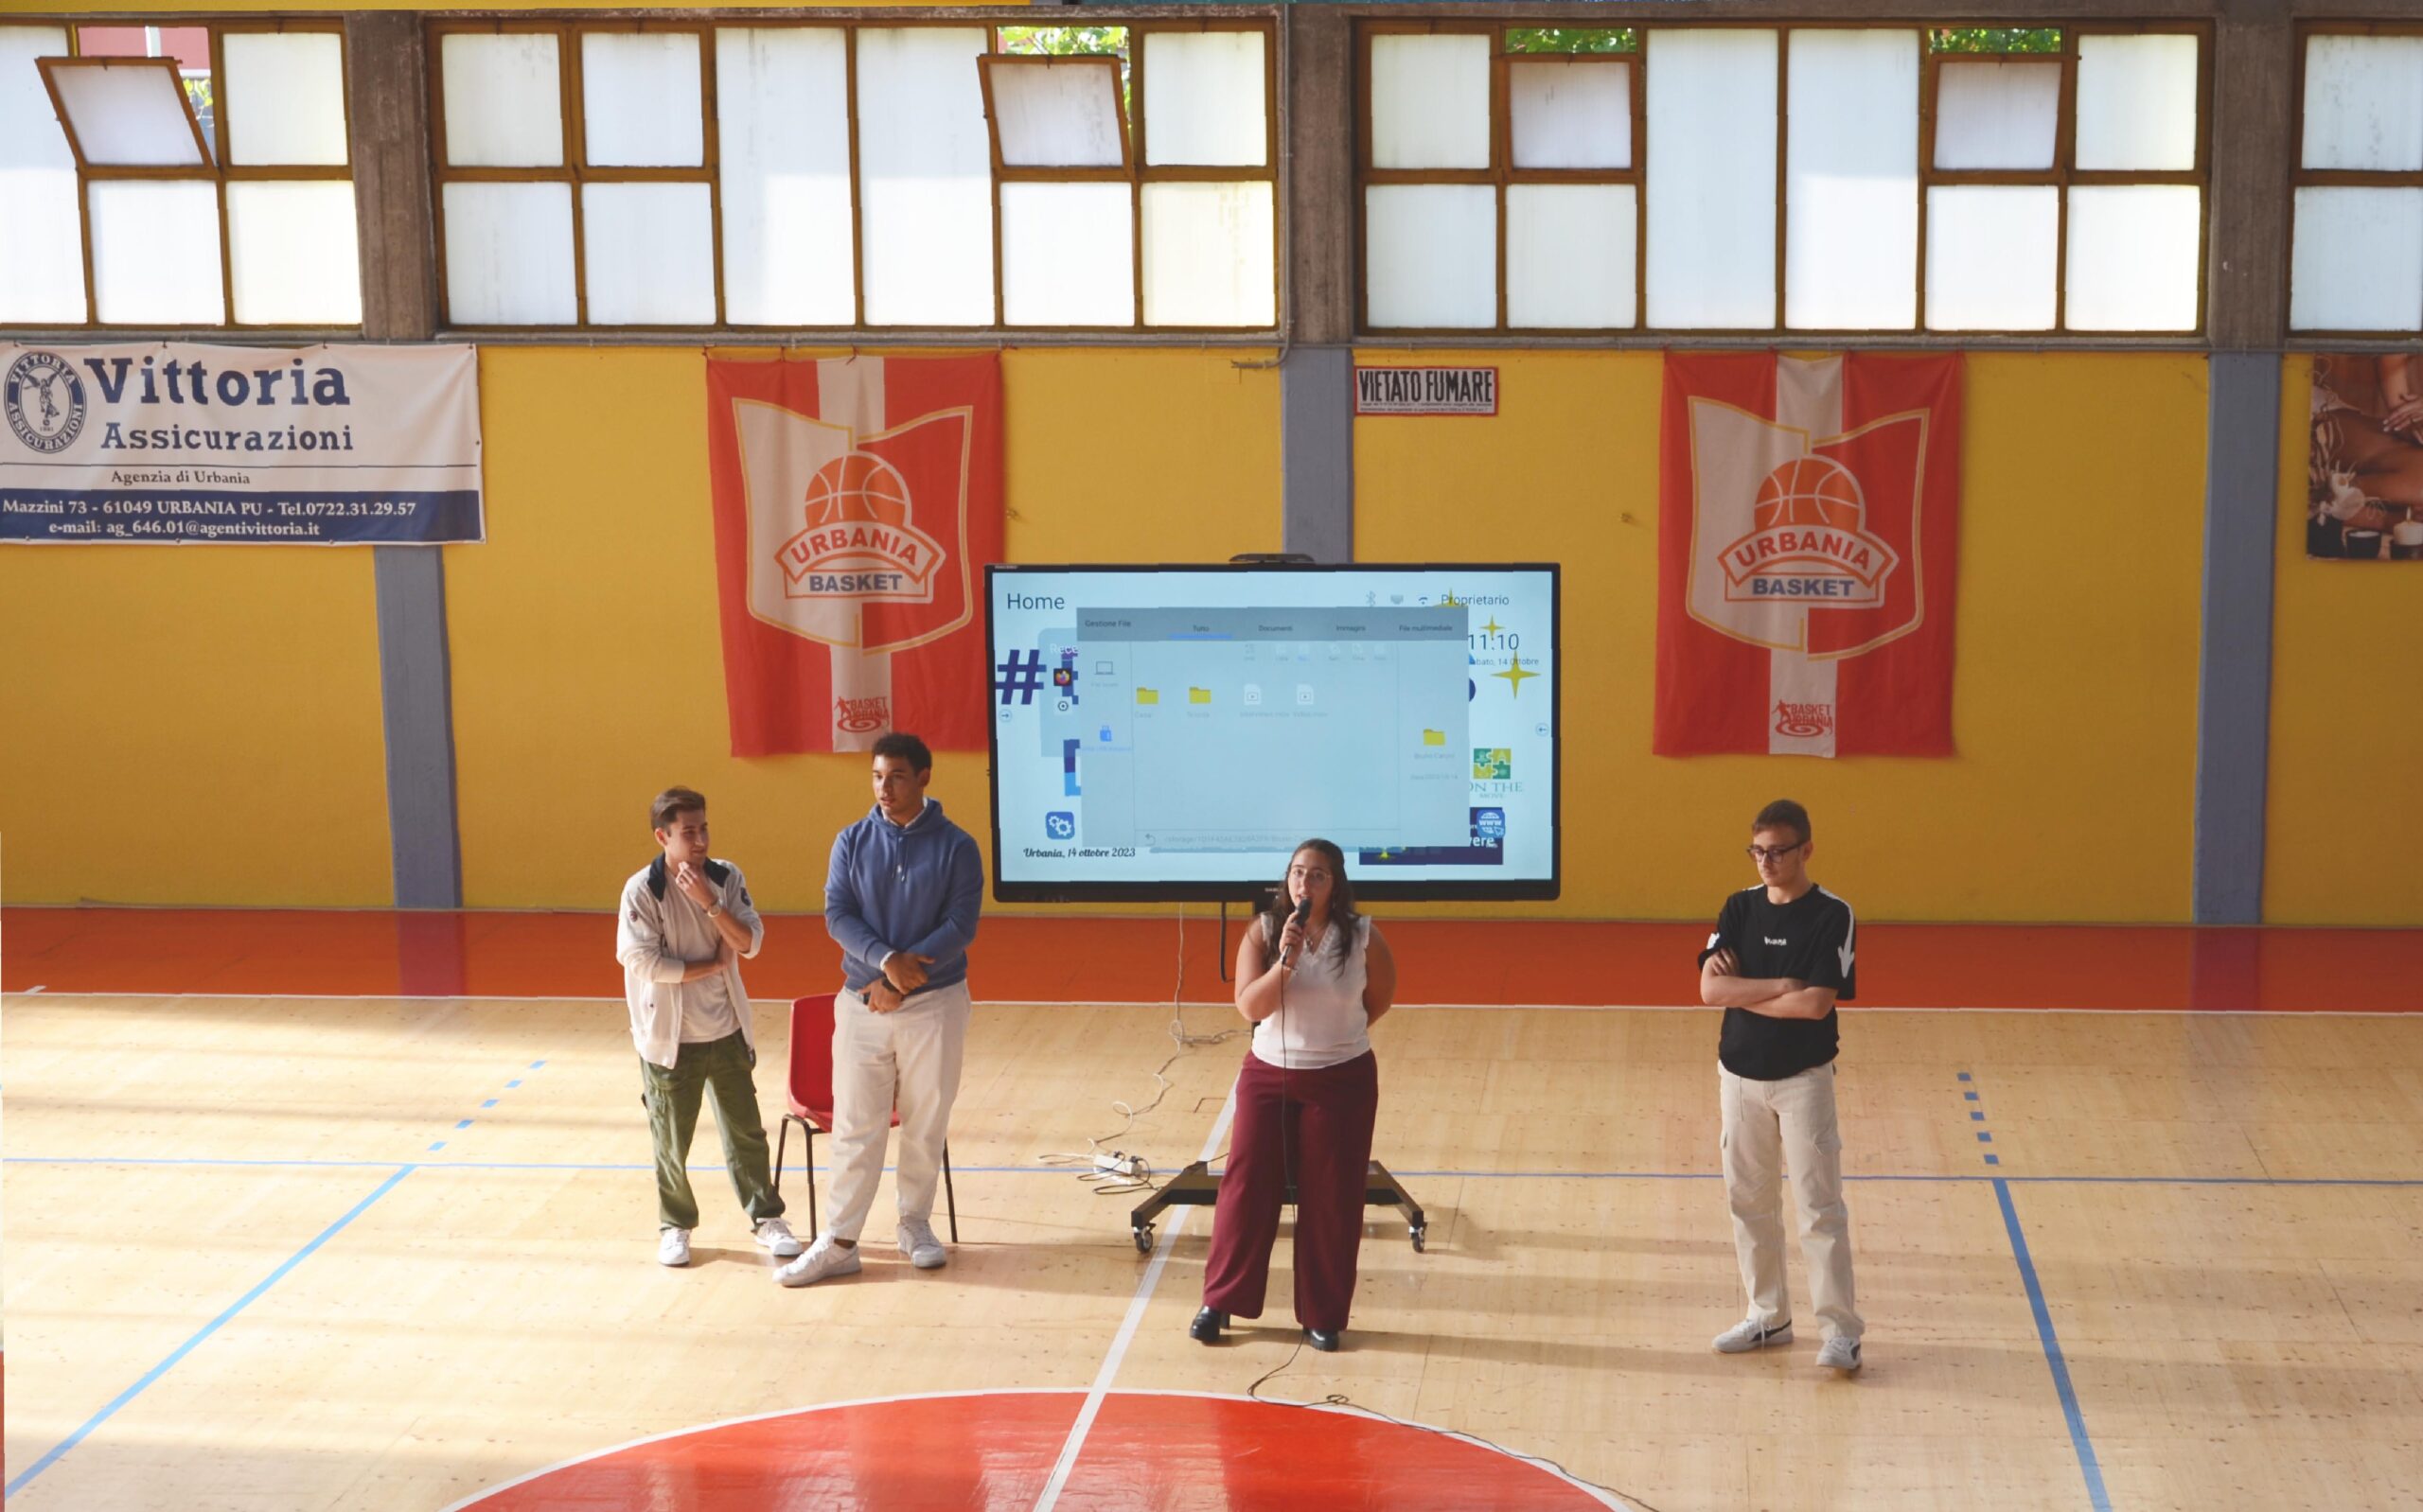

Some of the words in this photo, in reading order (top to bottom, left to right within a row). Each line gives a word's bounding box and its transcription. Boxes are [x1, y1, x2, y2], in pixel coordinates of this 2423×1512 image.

[9, 354, 76, 385] VITTORIA
[83, 355, 350, 407] Vittoria
[1359, 370, 1422, 402] VIETATO
[1425, 370, 1493, 403] FUMARE
[8, 402, 83, 451] ASSICURAZIONI
[100, 422, 354, 451] Assicurazioni
[111, 470, 171, 485] Agenzia
[176, 471, 190, 483] di
[194, 471, 251, 484] Urbania
[3, 500, 64, 514] Mazzini
[68, 501, 87, 514] 73
[102, 501, 152, 514] 61049
[157, 501, 237, 515] URBANIA
[240, 502, 262, 516] PU
[277, 501, 416, 517] Tel.0722.31.29.57
[48, 520, 101, 534] e-mail:
[106, 520, 320, 537] ag_646.01@agentivittoria.it
[790, 527, 919, 567] URBANIA
[1734, 531, 1871, 571] URBANIA
[809, 573, 903, 592] BASKET
[1752, 578, 1855, 597] BASKET
[1007, 592, 1066, 610] Home
[1441, 594, 1510, 608] Proprietario
[1085, 620, 1117, 628] Gestione
[1118, 620, 1132, 628] File
[1399, 624, 1410, 632] File
[1468, 633, 1520, 651] 11:10
[1497, 658, 1508, 666] 14
[1791, 703, 1832, 716] BASKET
[1495, 782, 1524, 793] THE
[1023, 848, 1066, 859] Urbania,
[1068, 848, 1077, 858] 14
[1078, 848, 1110, 858] ottobre
[1111, 847, 1136, 858] 2023
